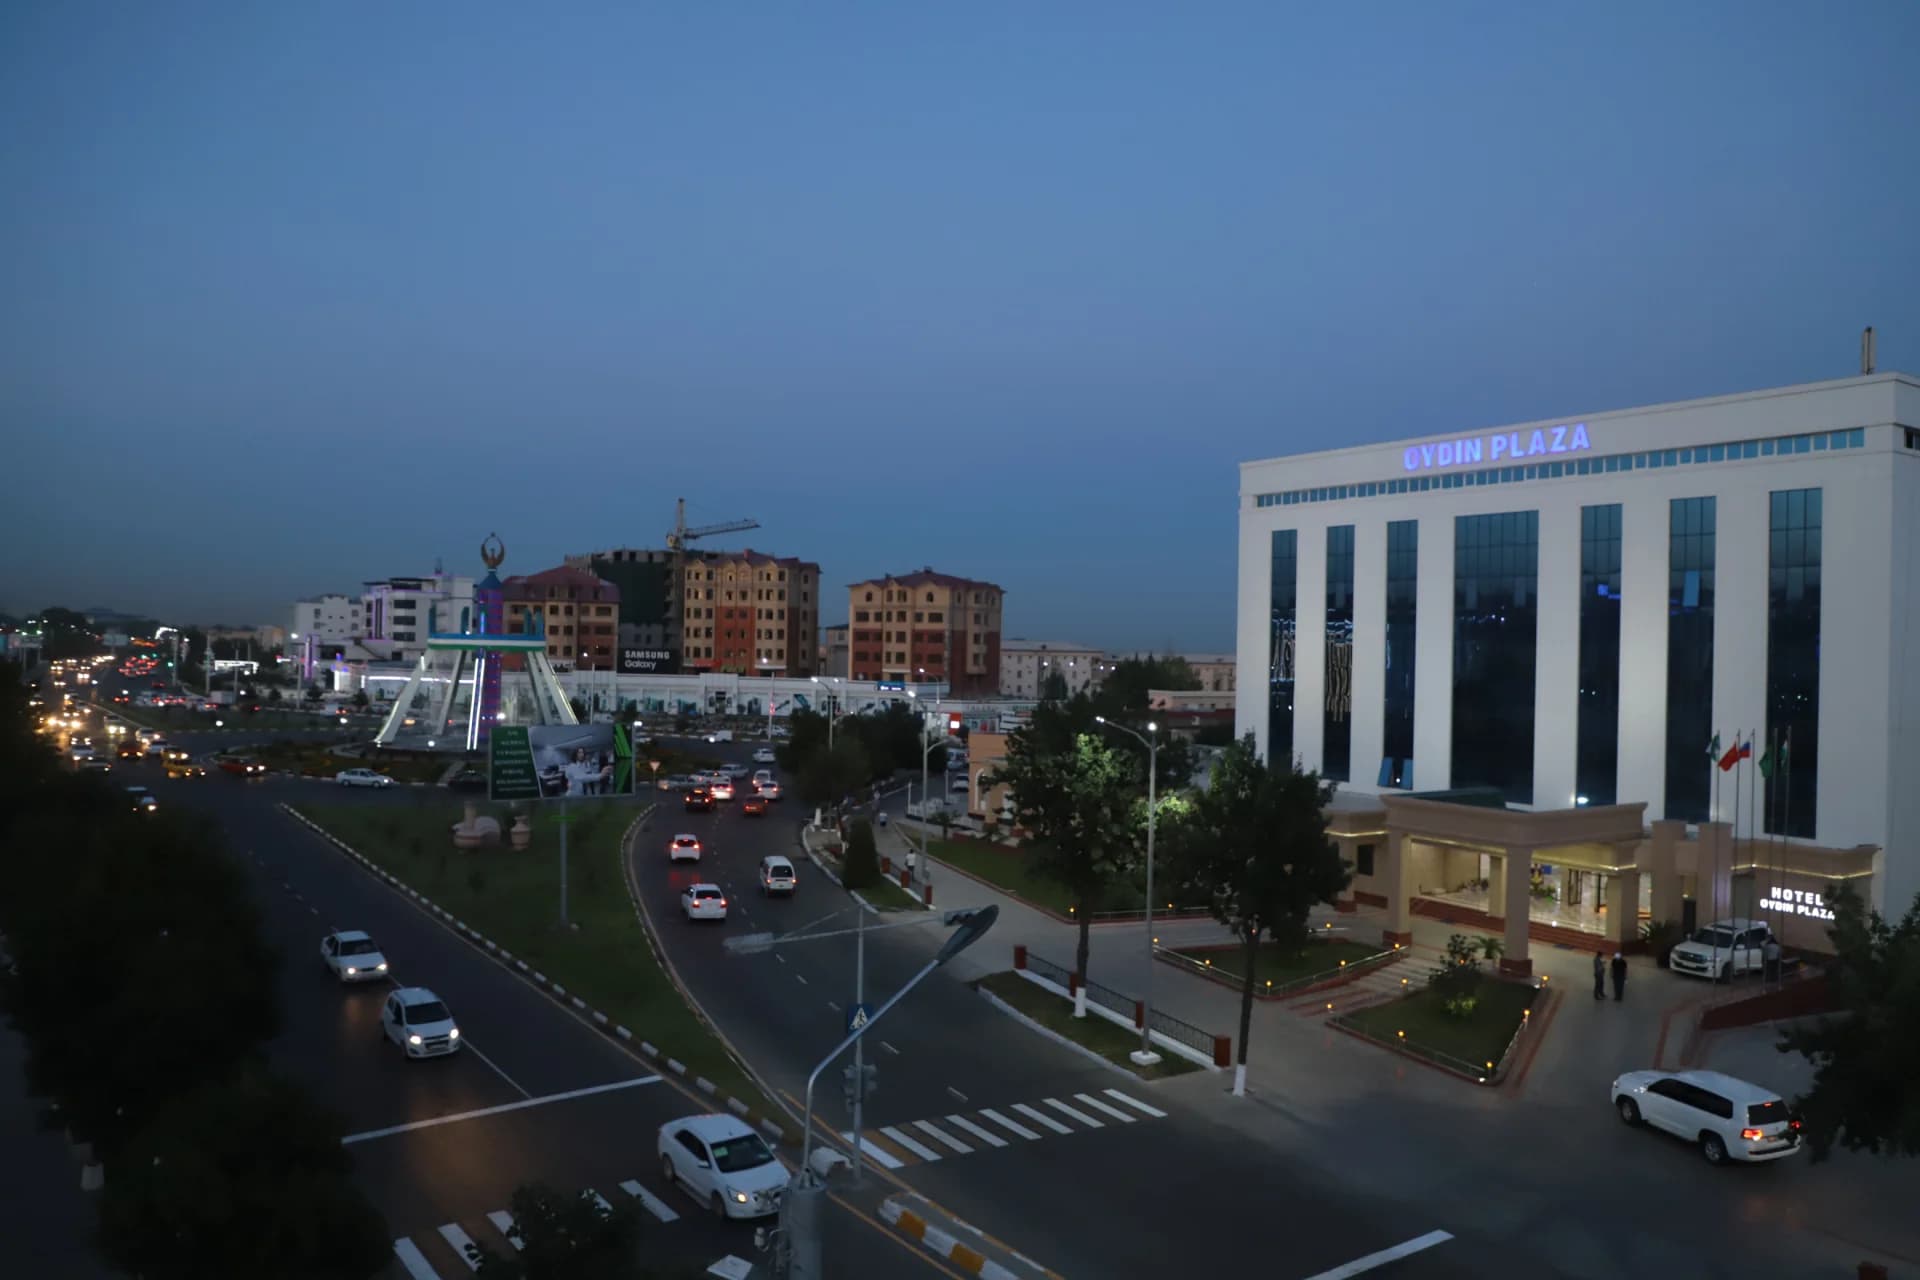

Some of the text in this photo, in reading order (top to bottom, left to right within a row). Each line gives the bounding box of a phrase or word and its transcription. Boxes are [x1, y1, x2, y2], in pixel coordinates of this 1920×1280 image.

[1404, 423, 1590, 471] OYDIN PLAZA
[624, 650, 670, 660] SAMSUNG
[624, 660, 657, 671] Galaxy
[1771, 886, 1824, 906] HOTEL
[1760, 898, 1835, 920] OYDIN PLAZA
